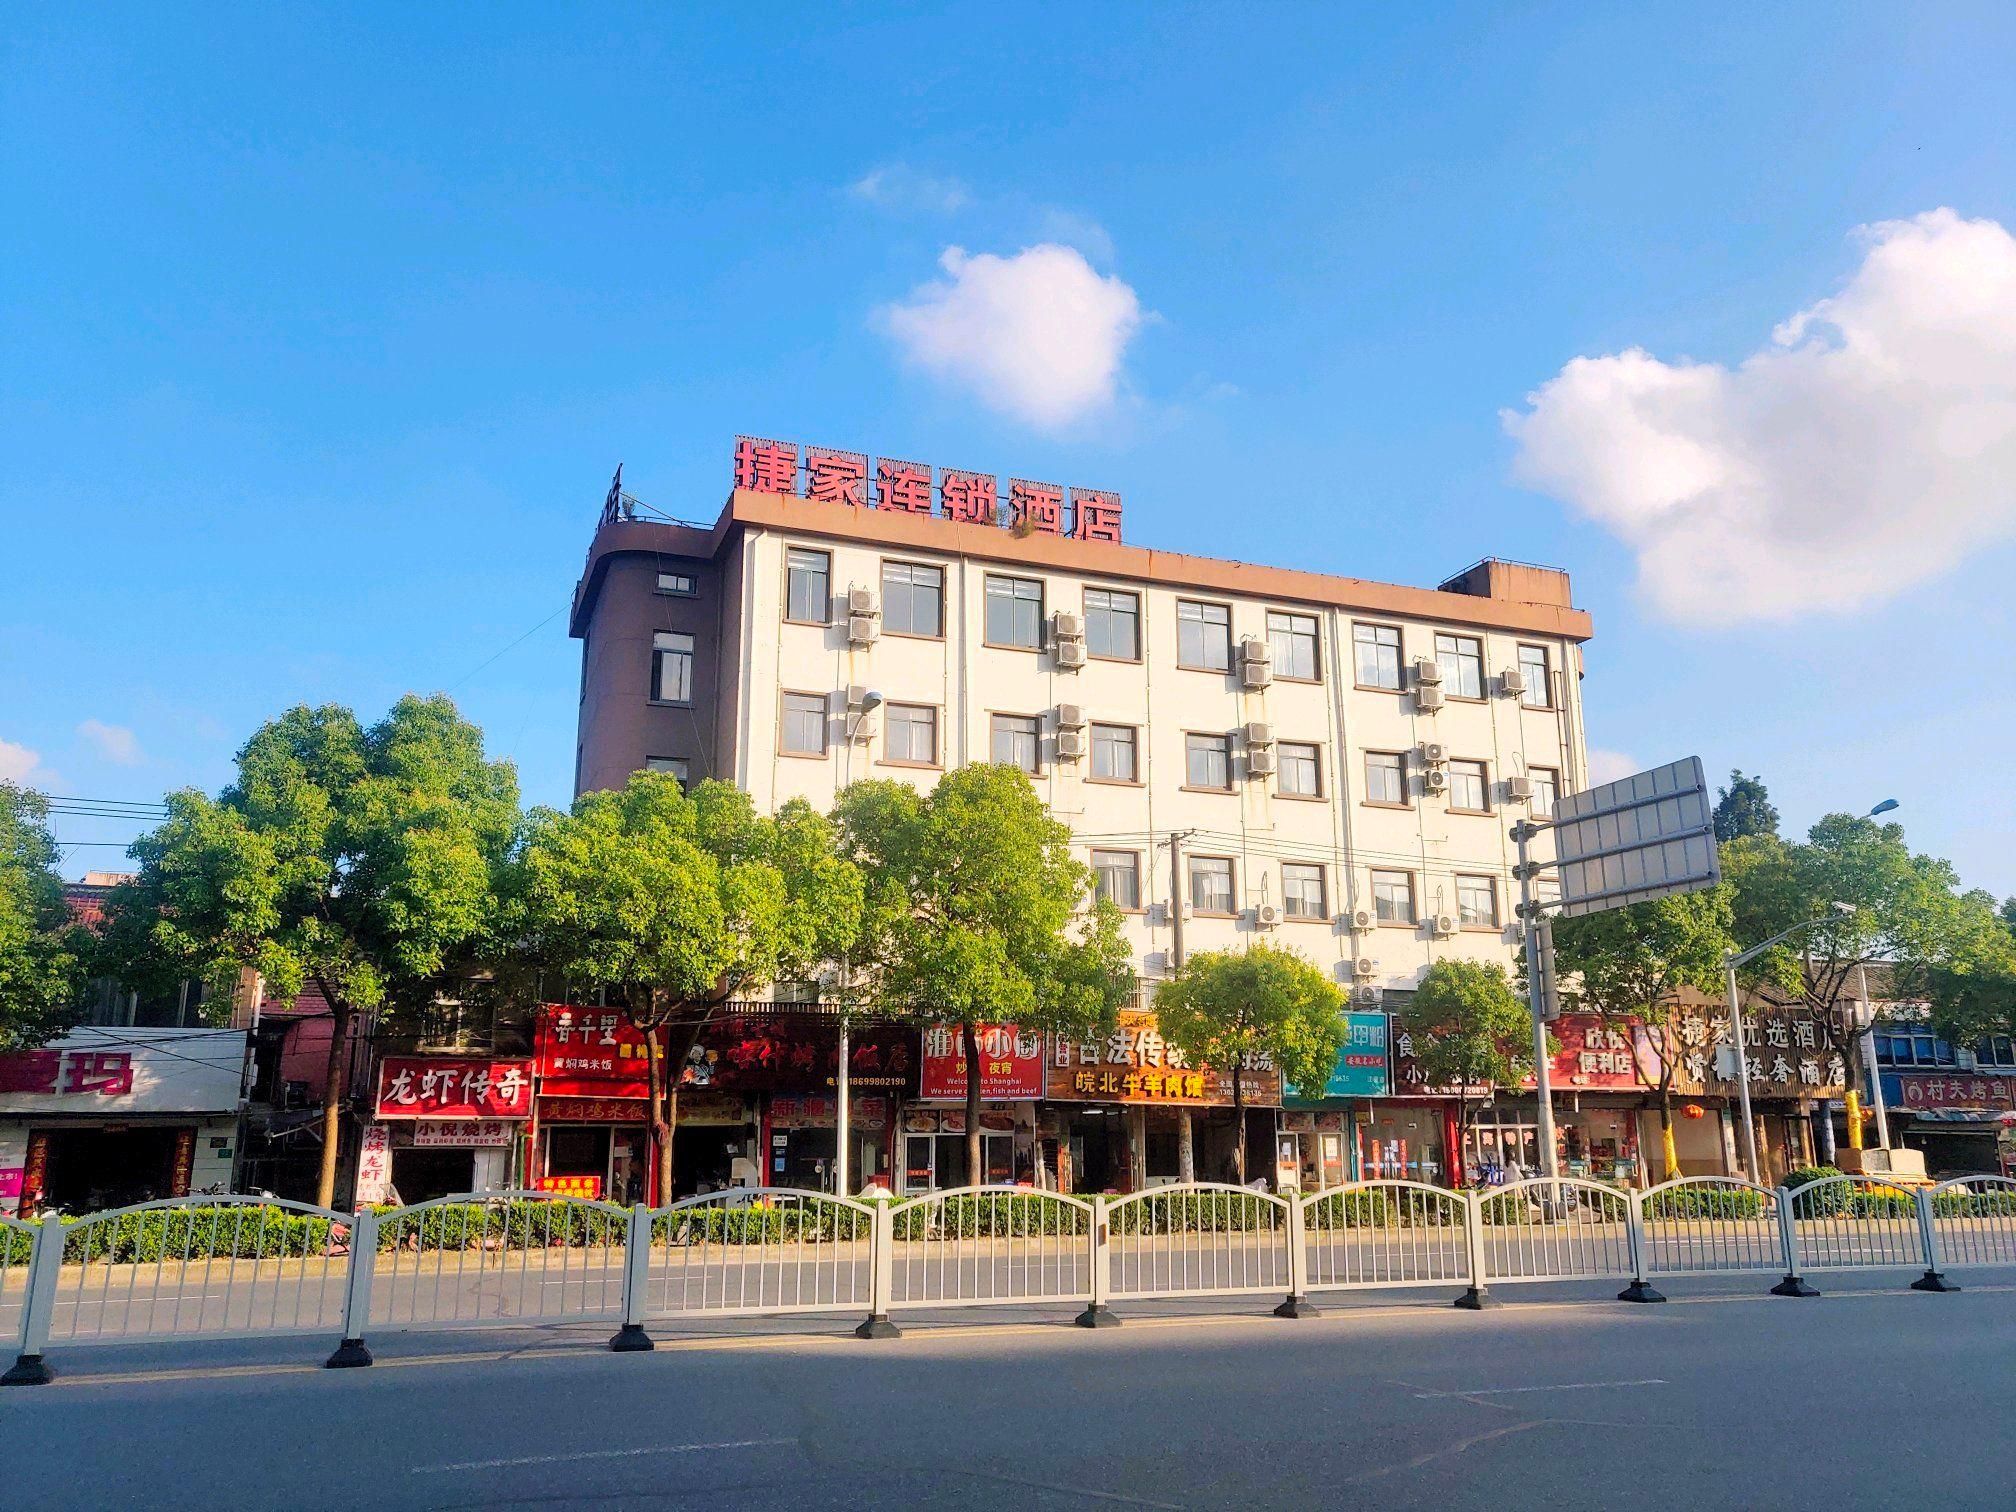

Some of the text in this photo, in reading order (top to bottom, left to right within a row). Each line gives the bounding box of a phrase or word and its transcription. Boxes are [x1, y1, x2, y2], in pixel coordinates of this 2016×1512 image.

[734, 441, 1122, 545] 捷家连锁酒店
[554, 1058, 612, 1070] 黄焖鸡米饭
[989, 1062, 1012, 1075] 夜宵
[1578, 1051, 1632, 1074] 便利店
[1685, 1053, 1845, 1086] 贤轻奢酒店
[383, 1067, 528, 1105] 龙虾传奇
[989, 1078, 1021, 1086] Shanghai
[1075, 1071, 1203, 1098] 皖北牛羊肉馆
[1927, 1080, 2009, 1101] 村夫烤鱼
[361, 1127, 387, 1181] 烧烤龙虾
